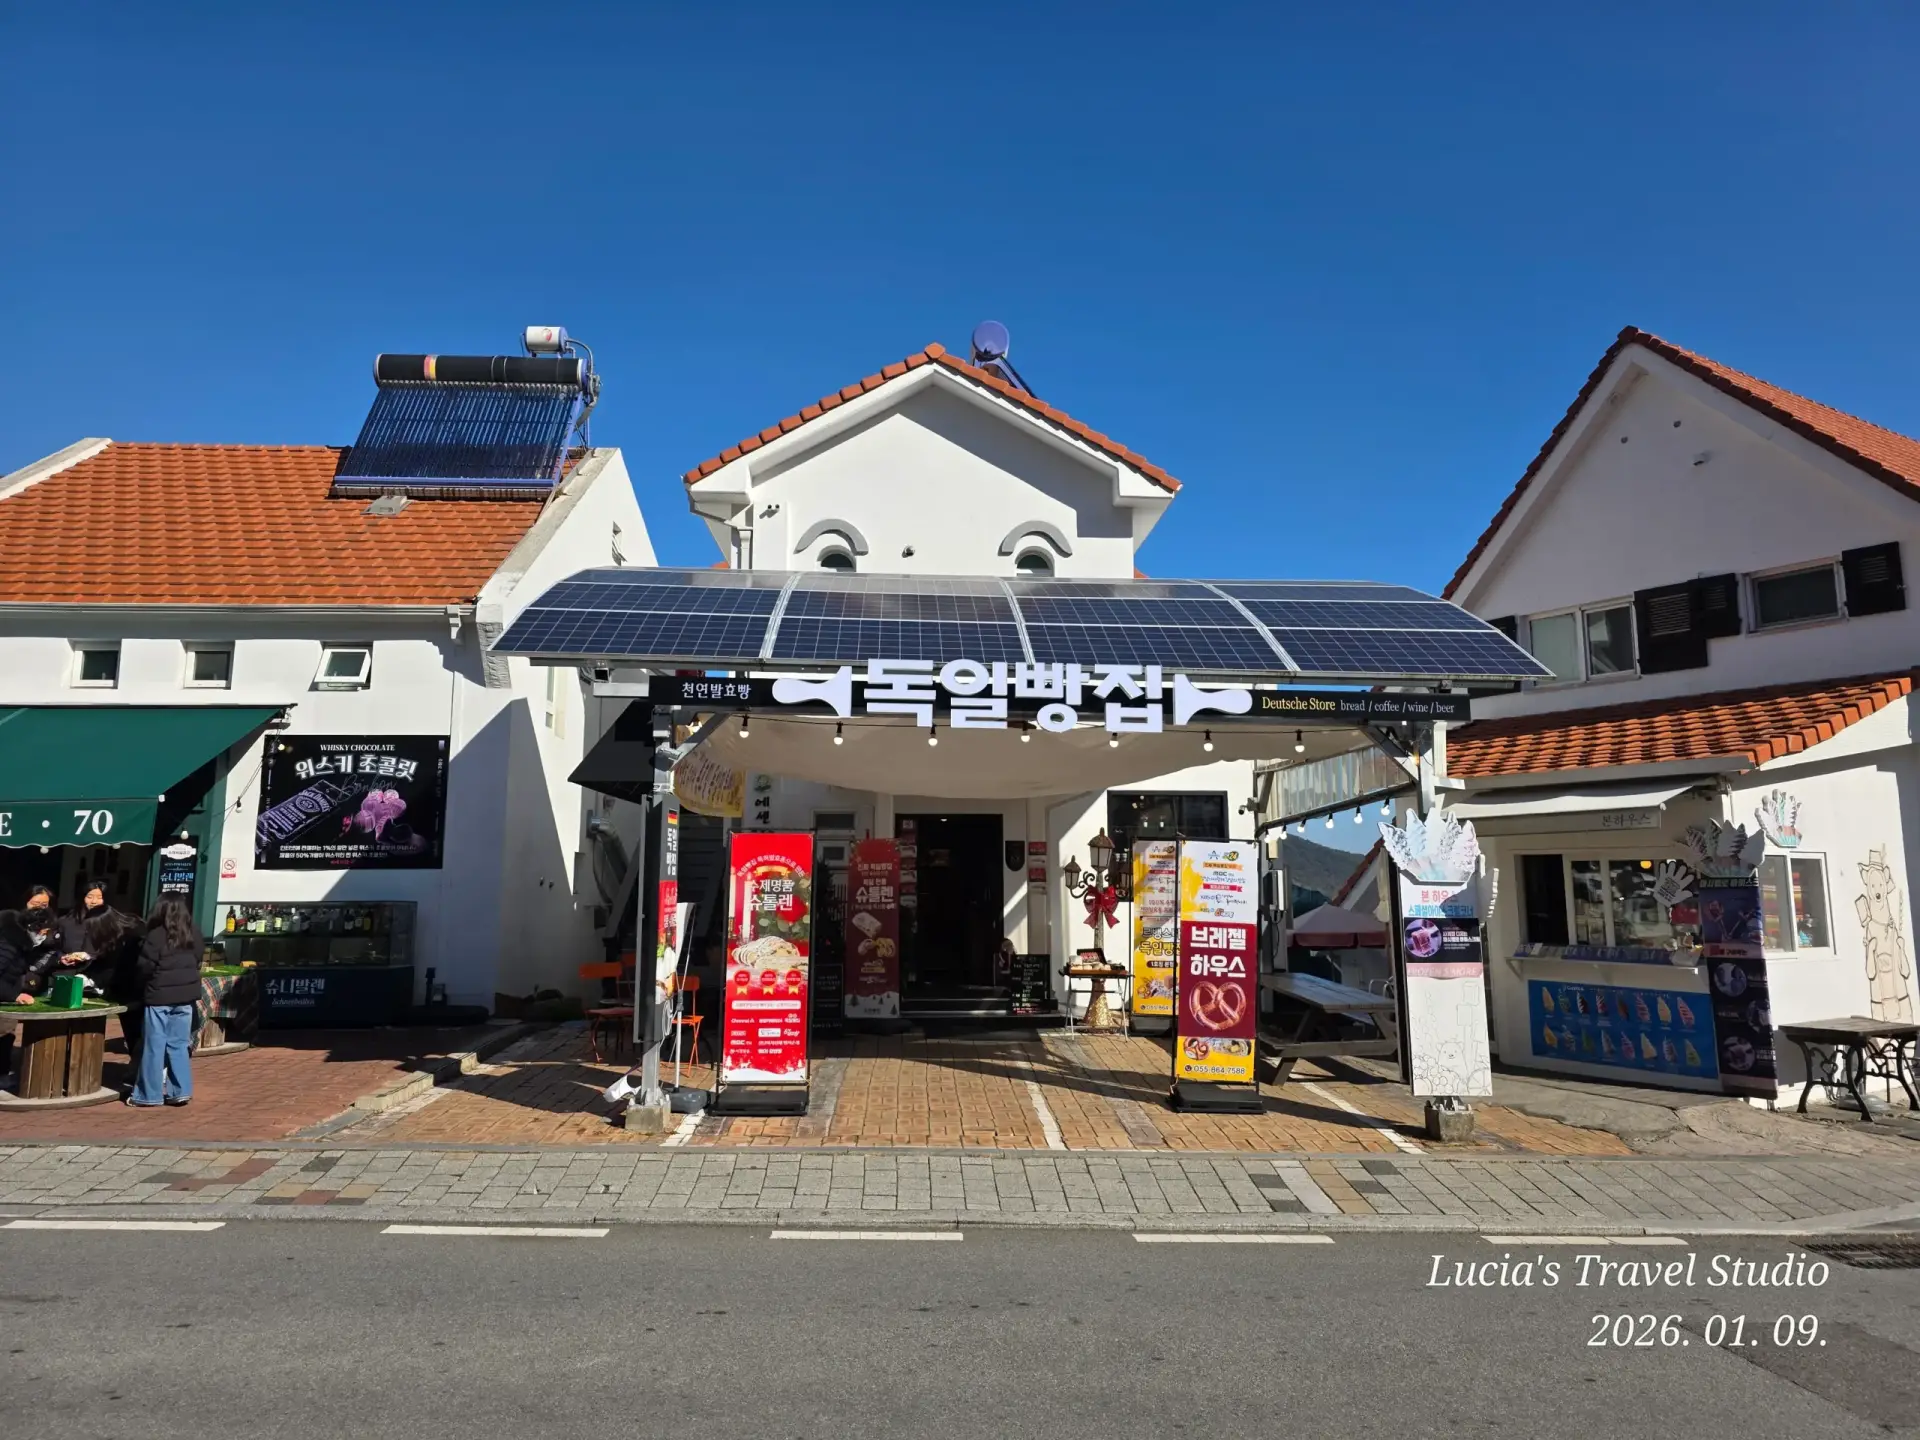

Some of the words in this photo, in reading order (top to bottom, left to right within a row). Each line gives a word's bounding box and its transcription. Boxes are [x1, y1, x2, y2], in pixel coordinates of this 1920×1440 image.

[681, 682, 752, 701] 천연발효빵
[864, 658, 1163, 733] 독일빵집
[1262, 696, 1307, 711] Deutsche
[1309, 697, 1336, 712] Store
[1340, 699, 1366, 712] bread
[1374, 700, 1400, 713] coffee
[1408, 702, 1429, 713] wine
[1435, 702, 1455, 714] beer
[295, 754, 353, 780] 위스키
[357, 753, 419, 782] 초콜릿
[73, 809, 114, 836] 70
[1601, 812, 1652, 827] 본하우스
[750, 879, 795, 892] 수제명품
[749, 894, 794, 911] 슈톨렌
[1190, 926, 1246, 950] 브레젤
[1190, 954, 1246, 978] 하우스
[265, 977, 326, 995] 슈니발렌
